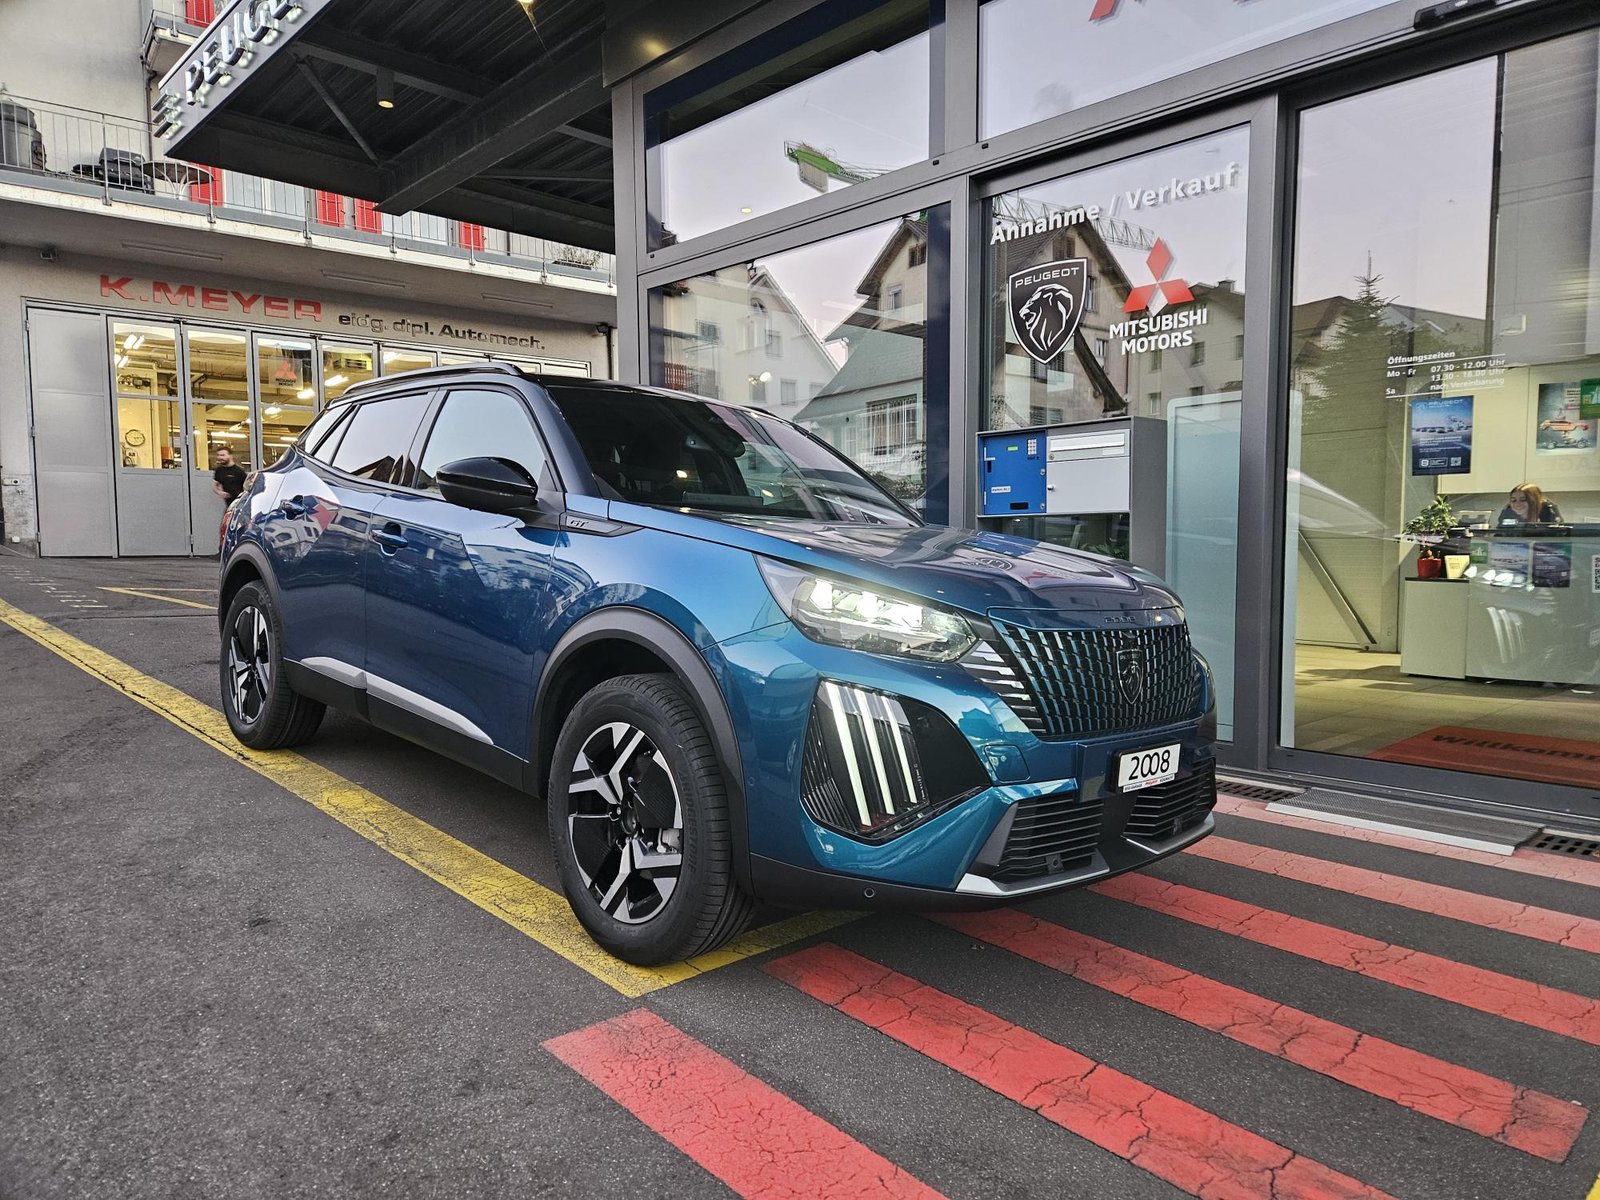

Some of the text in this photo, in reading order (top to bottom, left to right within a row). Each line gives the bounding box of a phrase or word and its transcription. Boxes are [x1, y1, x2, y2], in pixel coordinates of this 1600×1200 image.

[990, 161, 1242, 245] Annahme / Verkauf
[1015, 266, 1080, 289] PEUGEOT
[100, 274, 322, 322] K.MEYER
[338, 312, 546, 350] eidg. dipl. Automech.
[1109, 308, 1208, 340] MITSUBISHI
[1121, 329, 1193, 356] MOTORS
[1386, 370, 1400, 378] Mo
[1431, 364, 1454, 373] 07.30
[1463, 361, 1486, 369] 12.00
[1387, 351, 1456, 366] Öffnungszeiten
[1430, 383, 1448, 391] nach
[570, 519, 589, 527] GT
[1128, 749, 1171, 781] 2008
